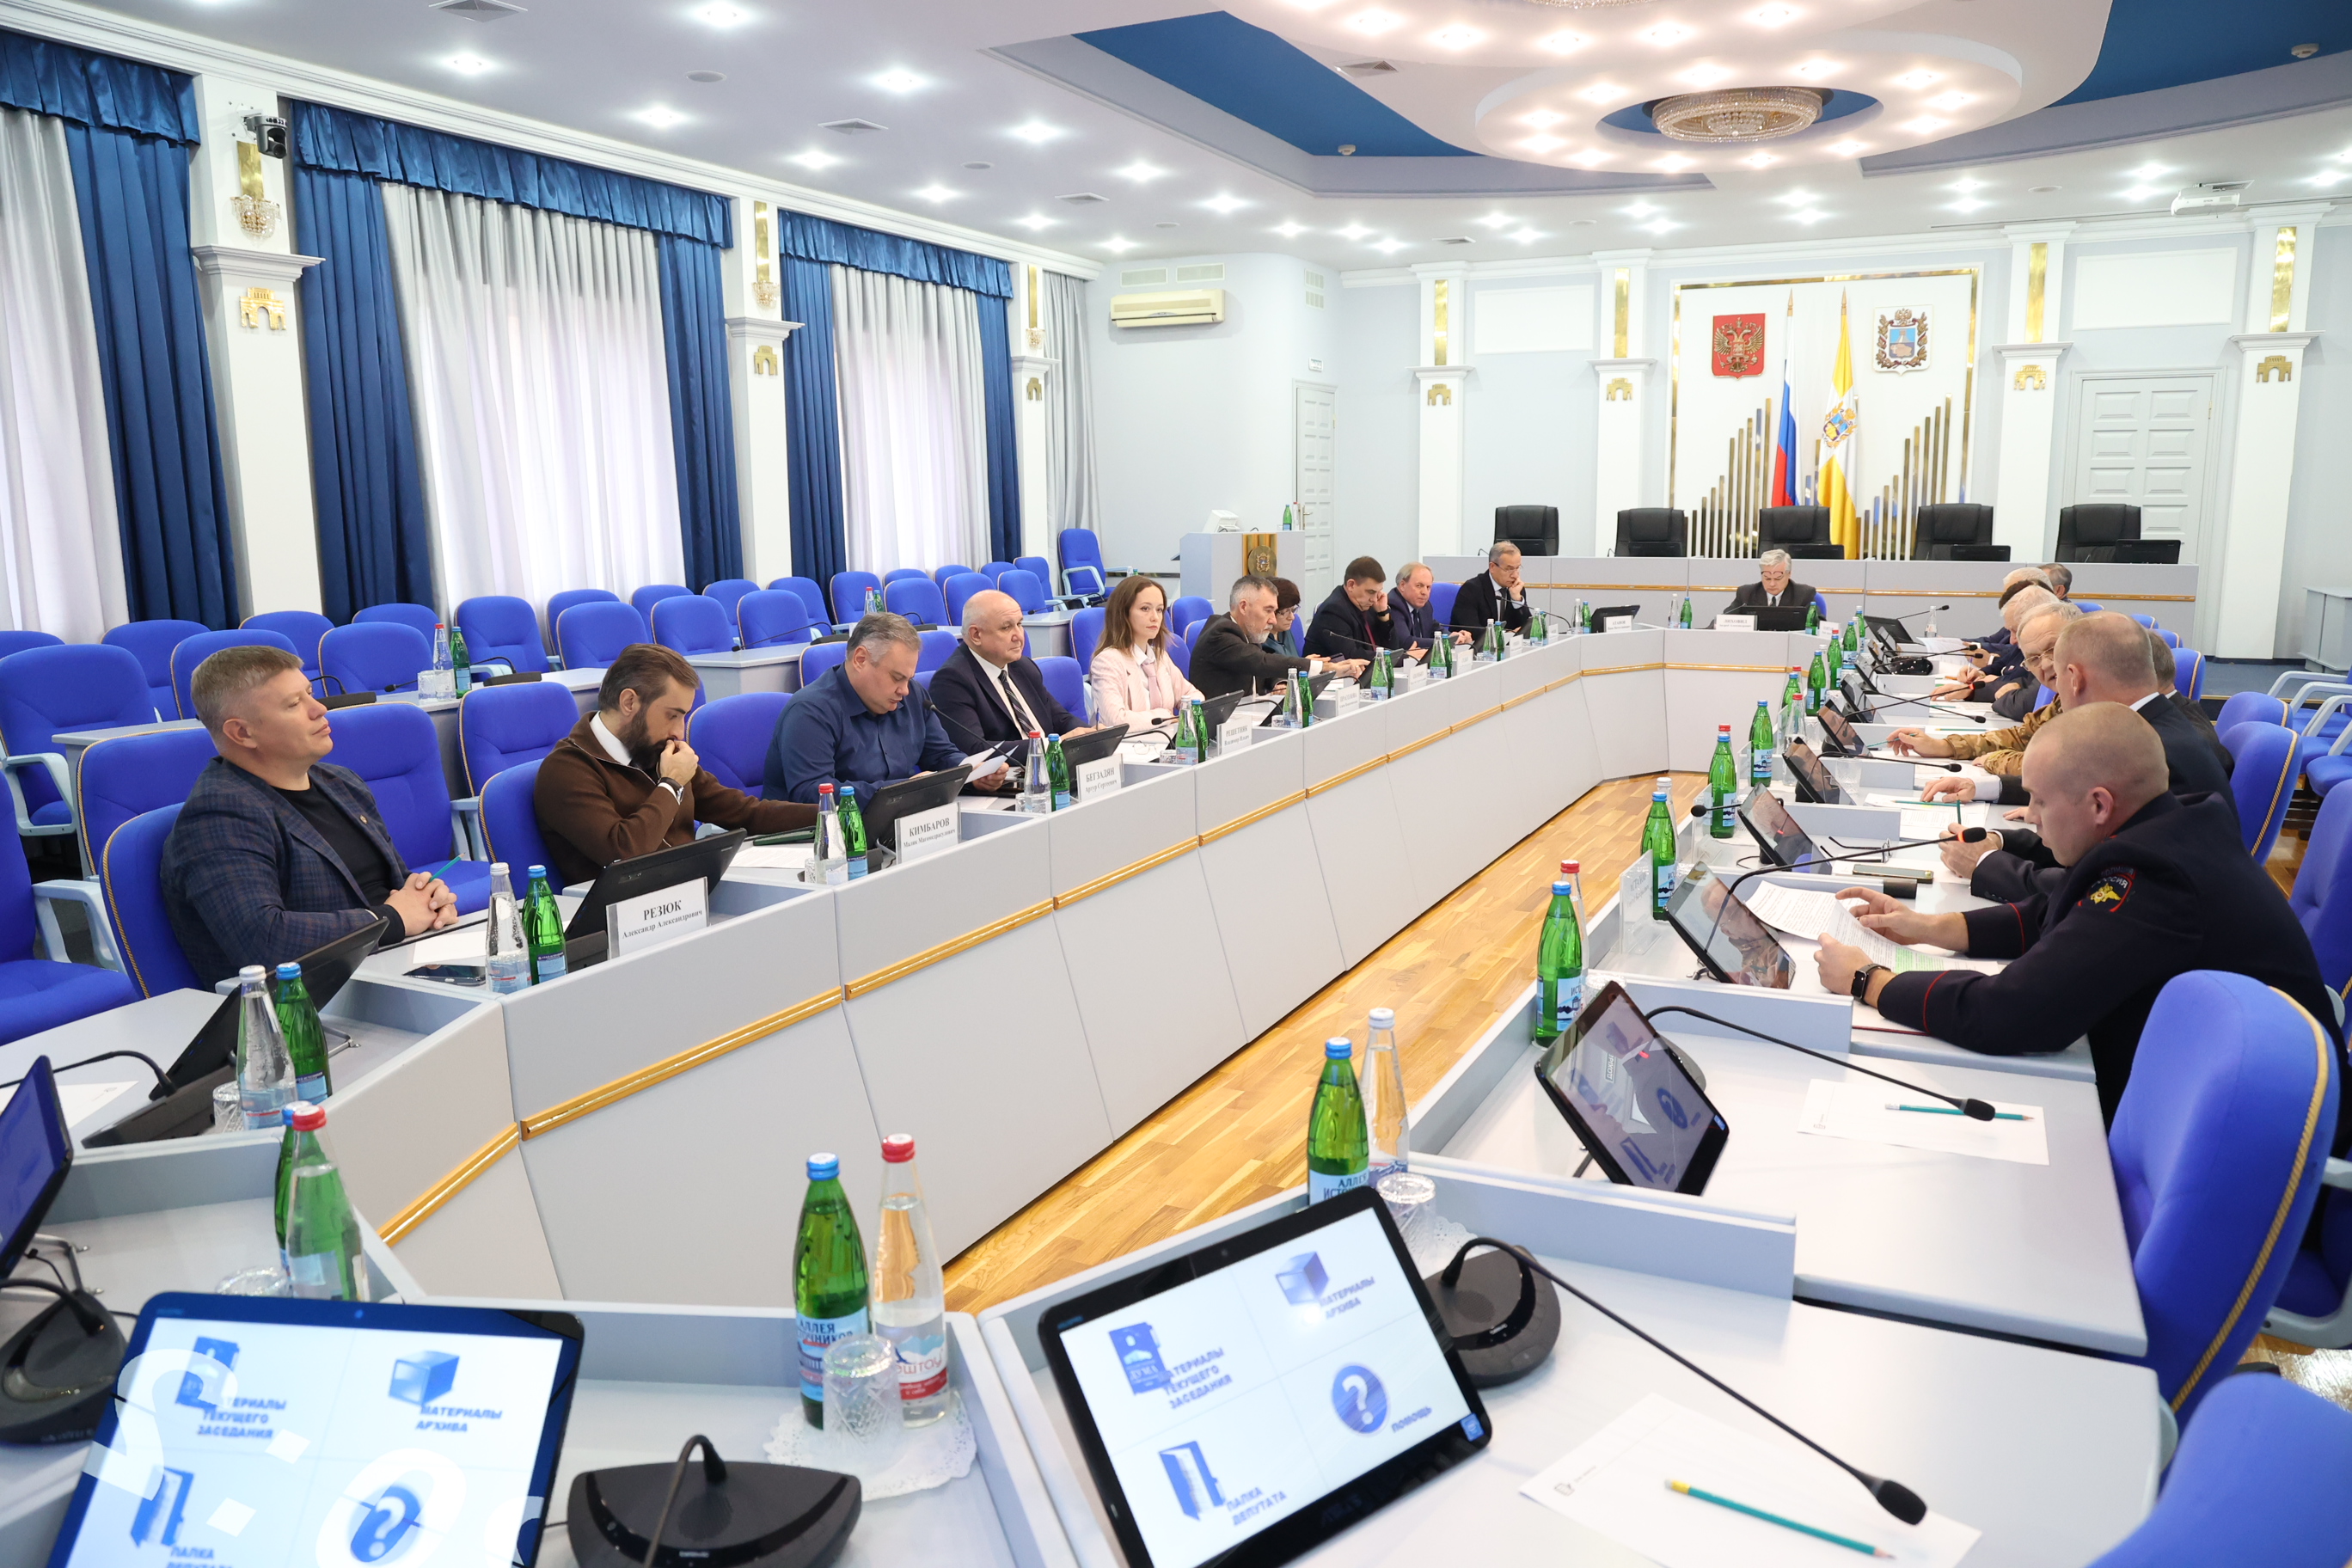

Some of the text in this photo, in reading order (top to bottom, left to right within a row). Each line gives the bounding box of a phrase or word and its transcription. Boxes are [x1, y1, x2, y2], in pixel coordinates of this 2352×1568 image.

[1086, 767, 1115, 782] БЕГЗАДЯН
[909, 818, 950, 837] КИМБАРОВ
[643, 900, 682, 921] РЕЗЮК
[622, 910, 702, 939] Александр Александрович
[1326, 1297, 1361, 1320] АРХИВА
[800, 1320, 835, 1333] АЛЛЕЯ
[1164, 1365, 1219, 1395] ТЕКУЩЕГО
[1169, 1375, 1232, 1409] ЗАСЕДАНИЯ
[415, 1420, 468, 1432] АРХИВА
[1391, 1406, 1432, 1432] ПОМОЩЬ
[197, 1424, 273, 1439] ЗАСЕДАНИЯ
[1233, 1490, 1286, 1527] ДЕПУТАТА
